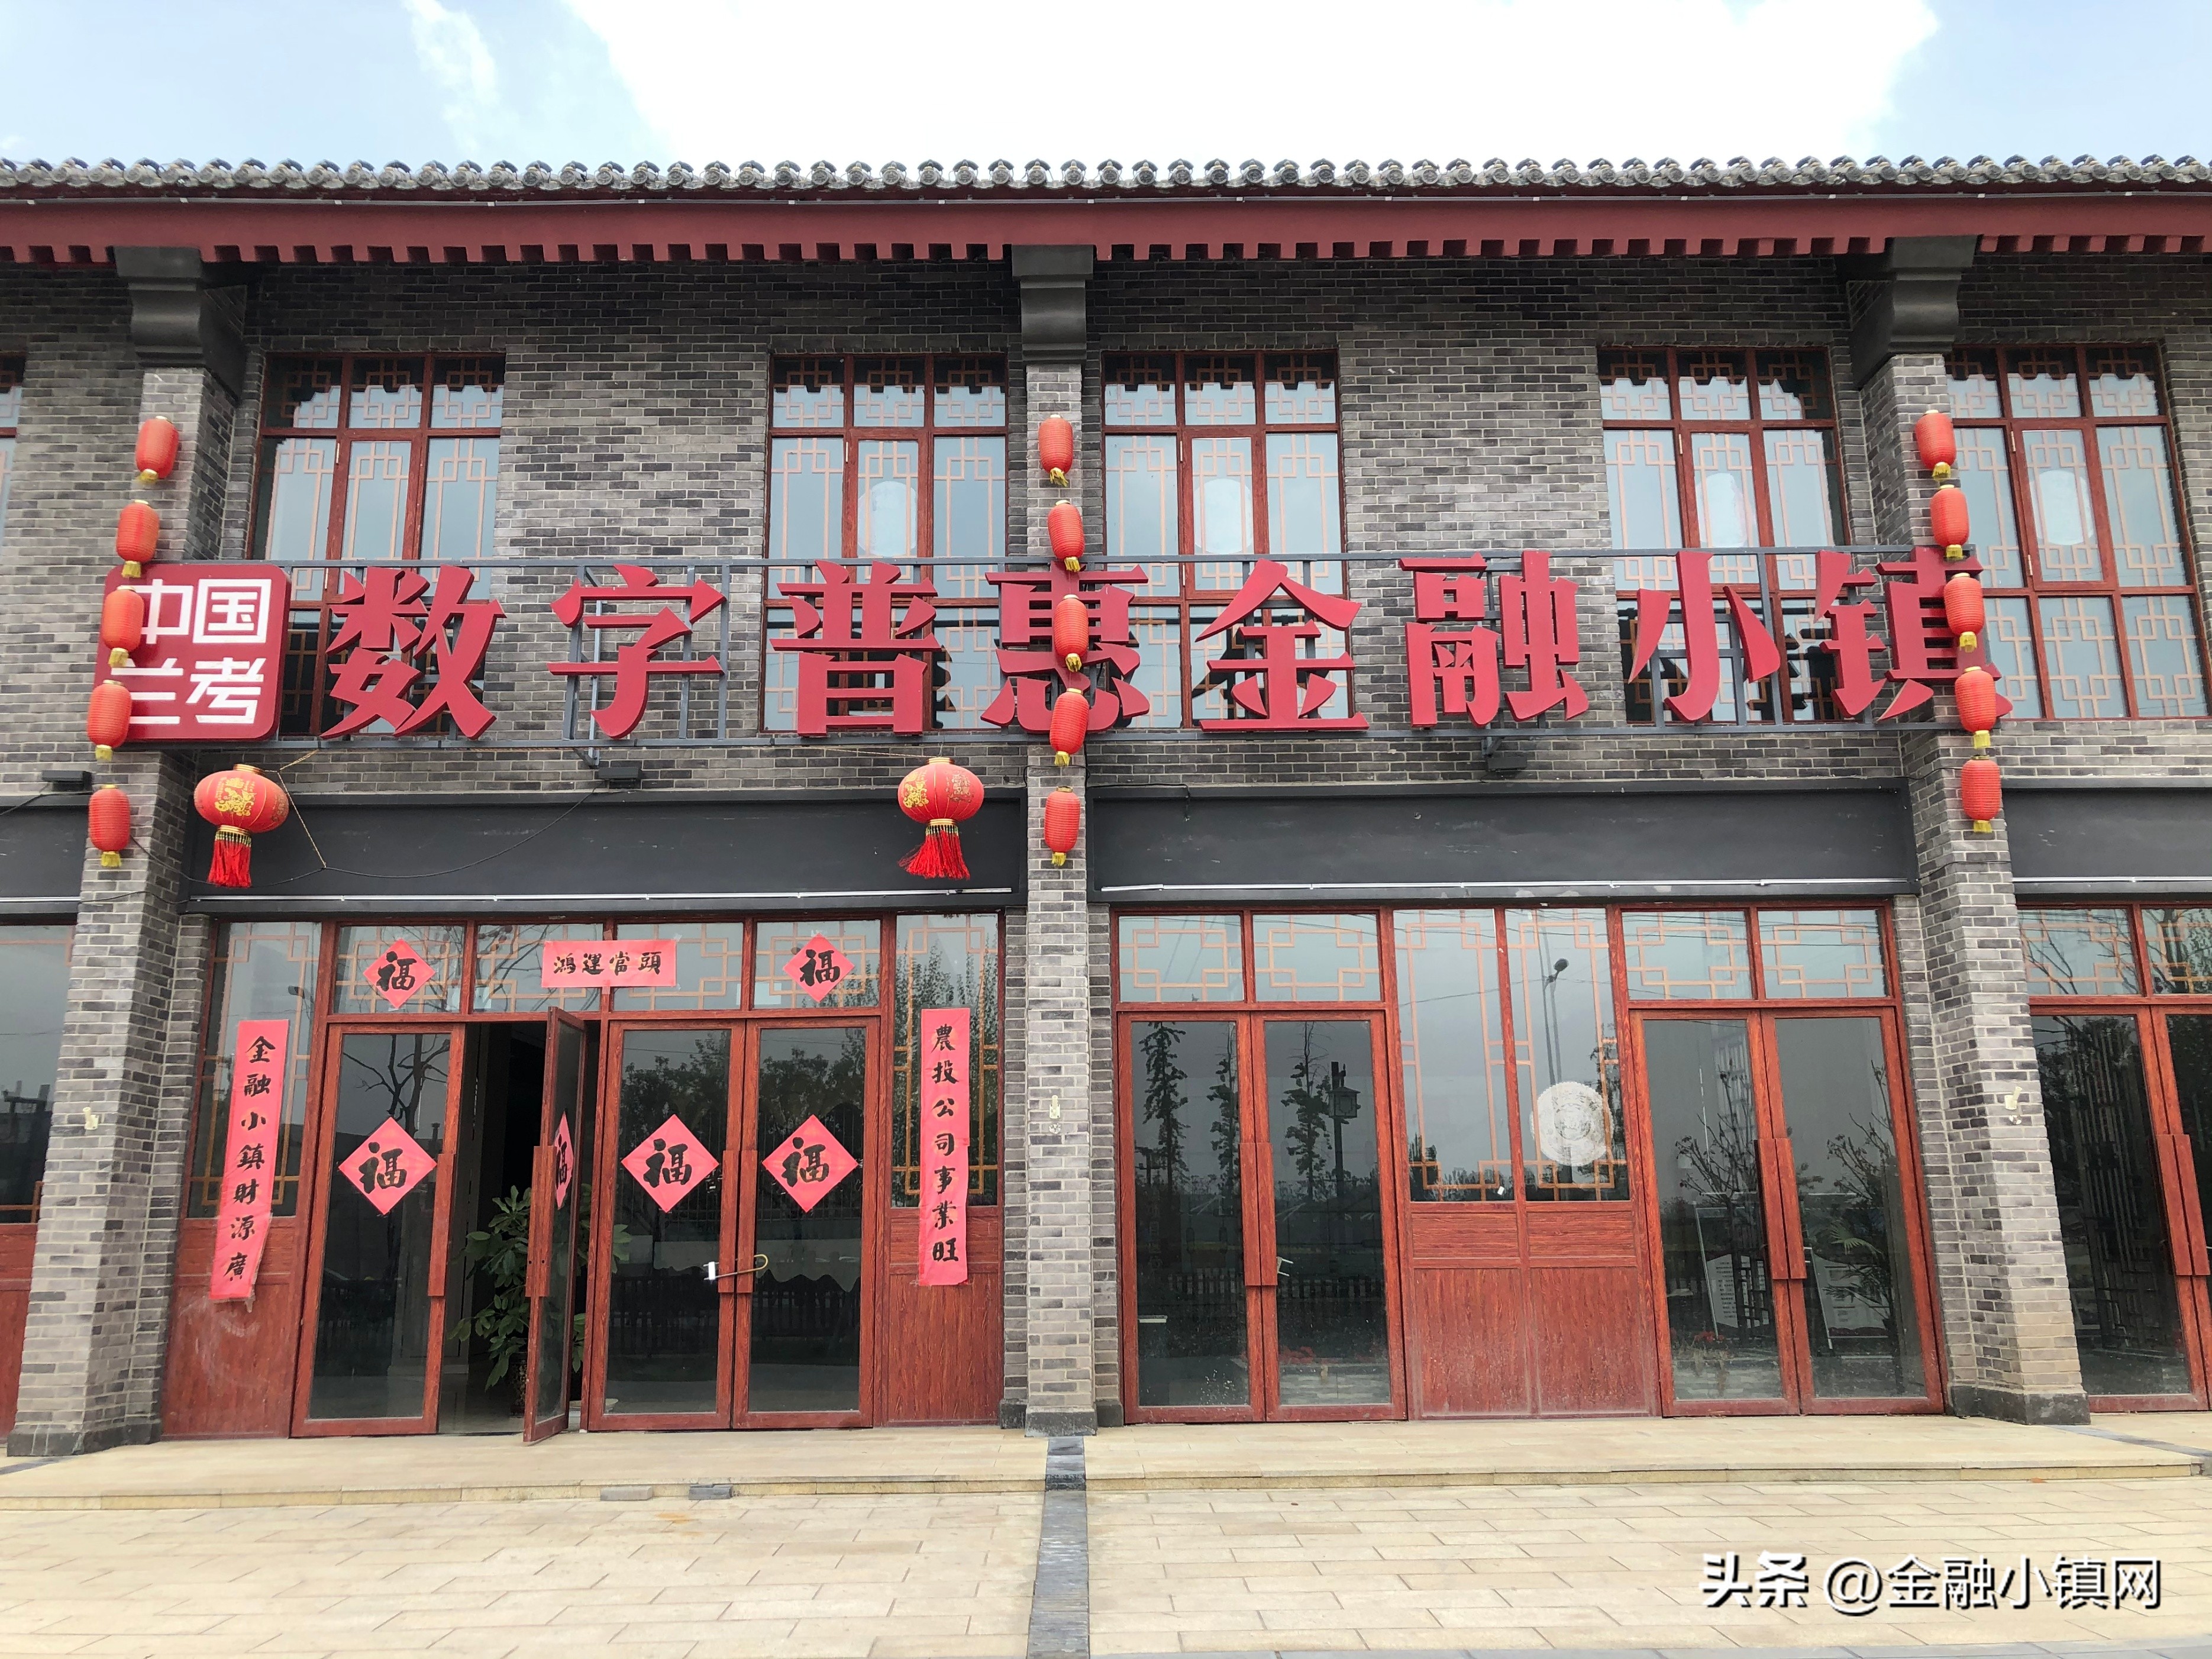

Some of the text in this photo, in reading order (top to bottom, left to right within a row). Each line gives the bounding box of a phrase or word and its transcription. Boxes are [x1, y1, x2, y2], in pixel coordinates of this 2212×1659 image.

[133, 579, 272, 644] 中国
[321, 547, 2013, 740] 数字普惠金融小镇
[111, 657, 267, 724] 兰考
[376, 951, 418, 992] 福
[799, 949, 841, 986] 福
[222, 1035, 276, 1282] 金融小鎮財源廣
[359, 1141, 408, 1194] 福
[643, 1137, 692, 1189] 福
[780, 1136, 831, 1187] 福
[931, 1023, 960, 1263] 農投公司事業旺
